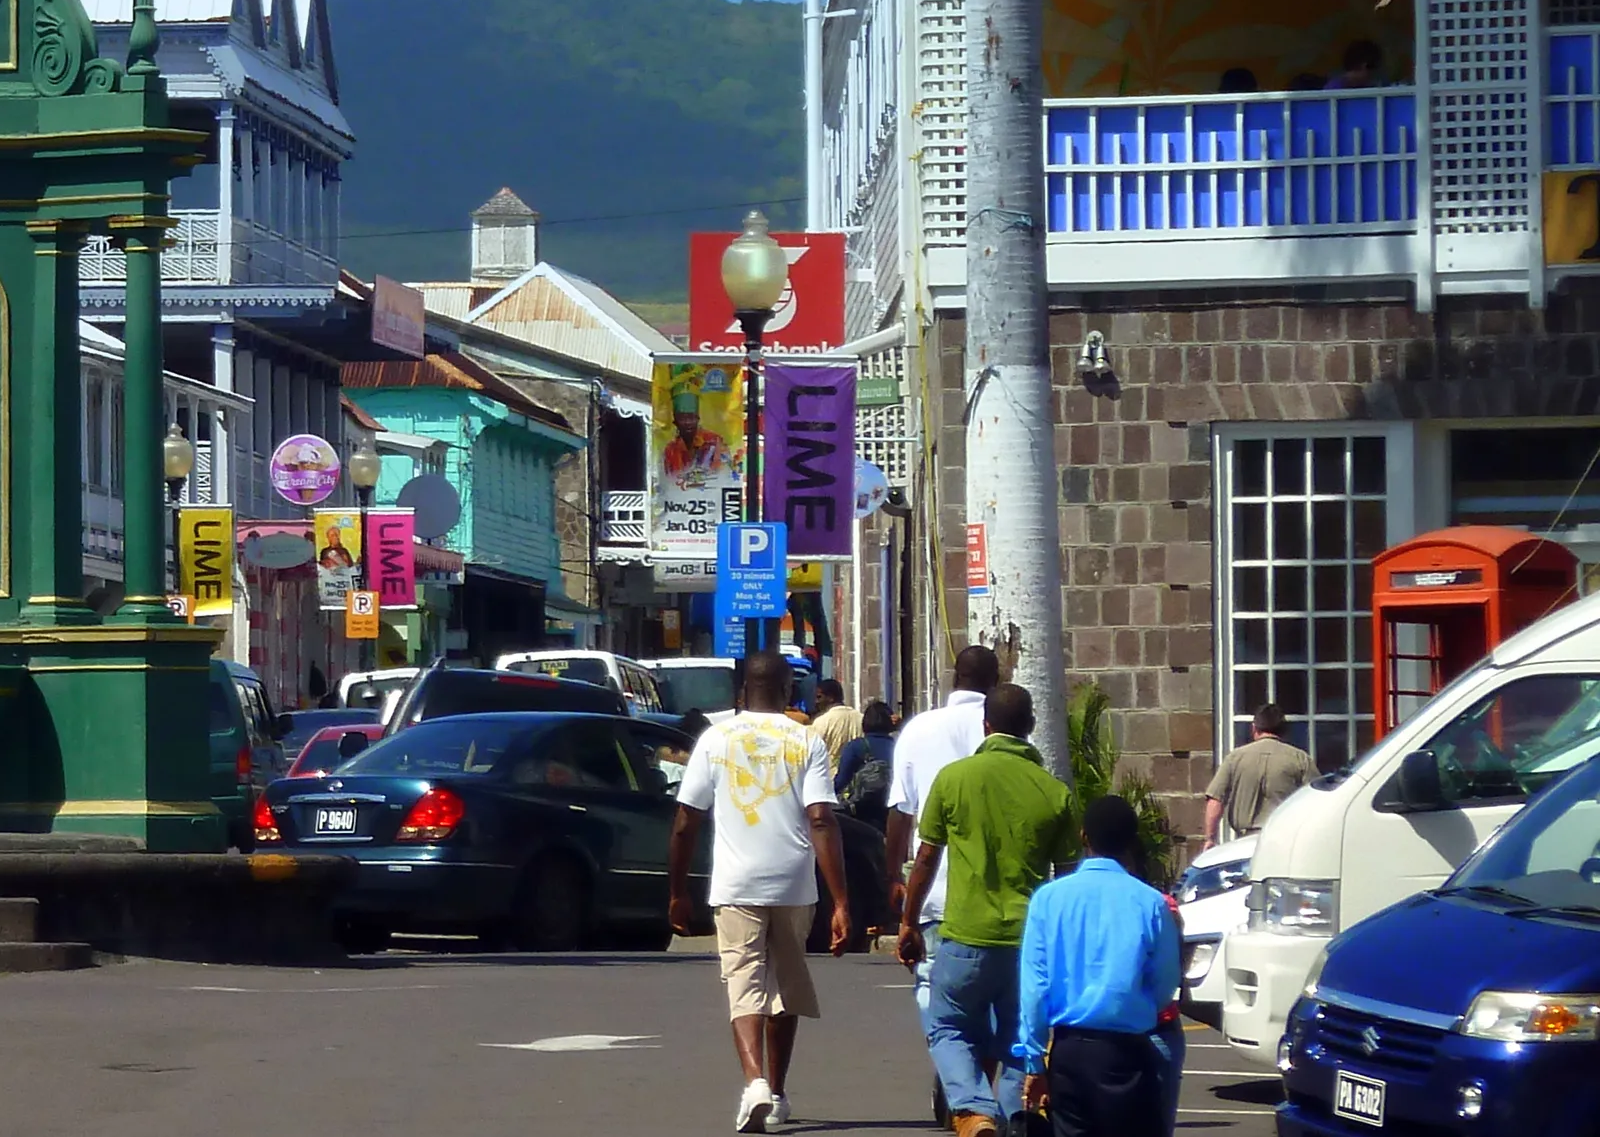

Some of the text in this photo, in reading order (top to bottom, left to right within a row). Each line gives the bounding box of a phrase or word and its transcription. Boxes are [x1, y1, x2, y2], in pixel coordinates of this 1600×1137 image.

[699, 341, 836, 355] Scotabank
[785, 385, 838, 533] LIME
[724, 491, 741, 522] LIM
[194, 520, 221, 600] LIME
[379, 522, 406, 596] LIME
[740, 528, 769, 565] P
[743, 572, 775, 580] minutes
[743, 582, 763, 590] ONLY
[319, 811, 328, 830] P
[1339, 1080, 1353, 1109] PA
